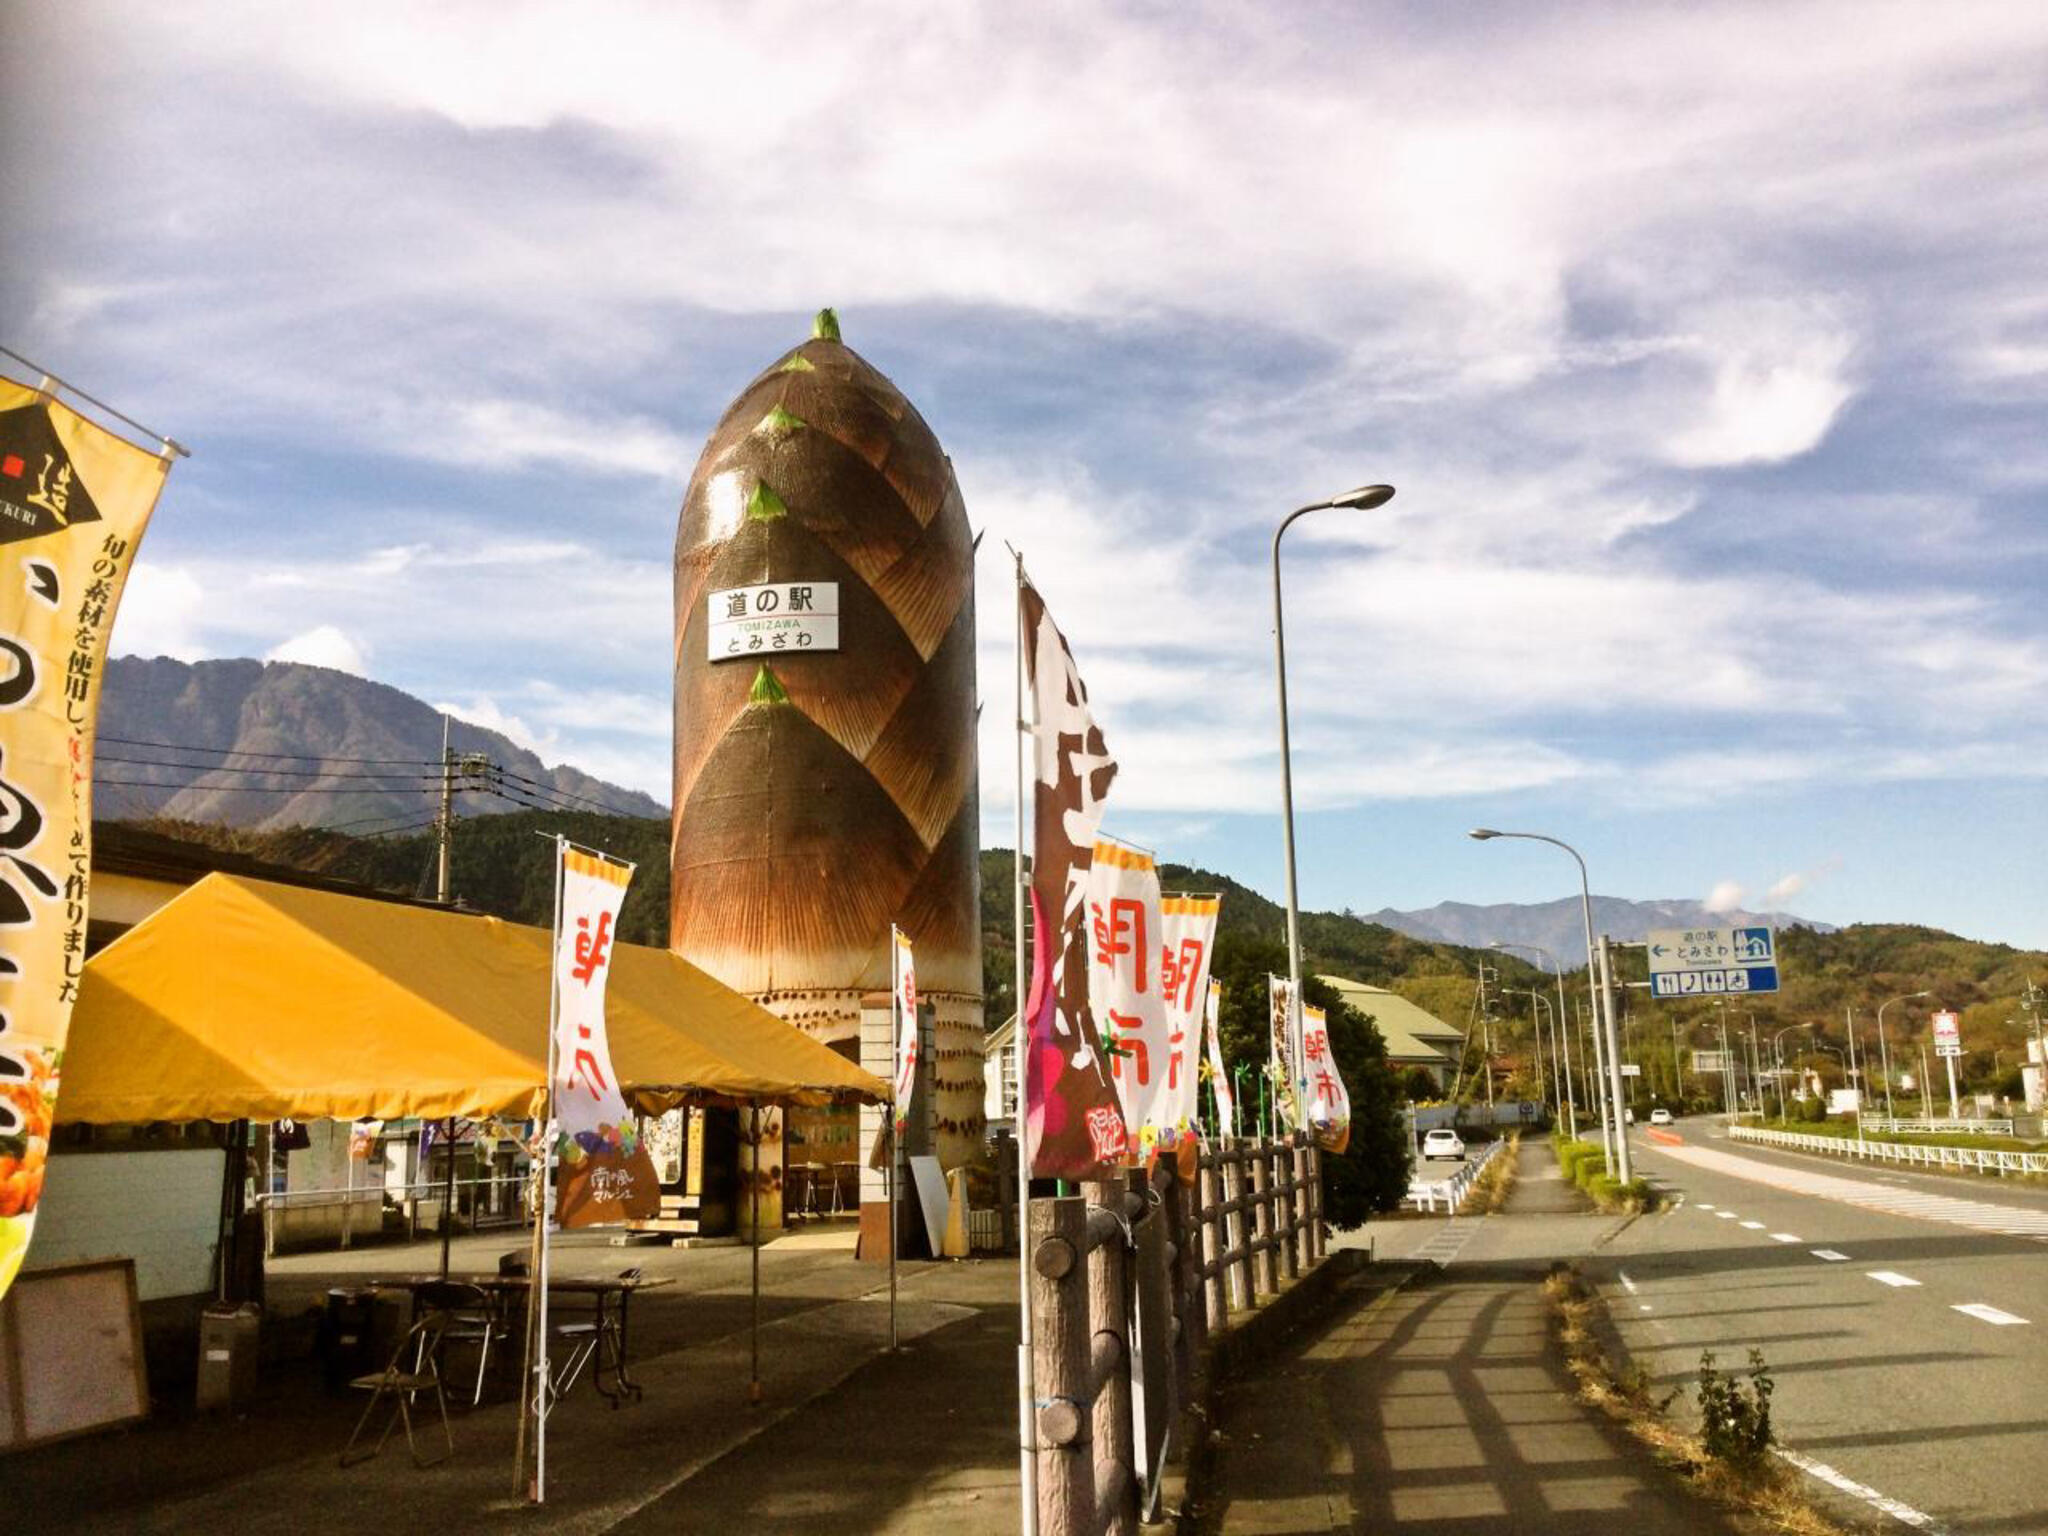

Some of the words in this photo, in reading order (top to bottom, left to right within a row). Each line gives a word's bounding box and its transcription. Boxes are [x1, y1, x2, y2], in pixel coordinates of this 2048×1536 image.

[727, 586, 813, 619] 道の駅
[738, 618, 801, 632] TOMIZAWA
[727, 631, 812, 653] とみざわ
[1305, 1029, 1342, 1108] 朝市
